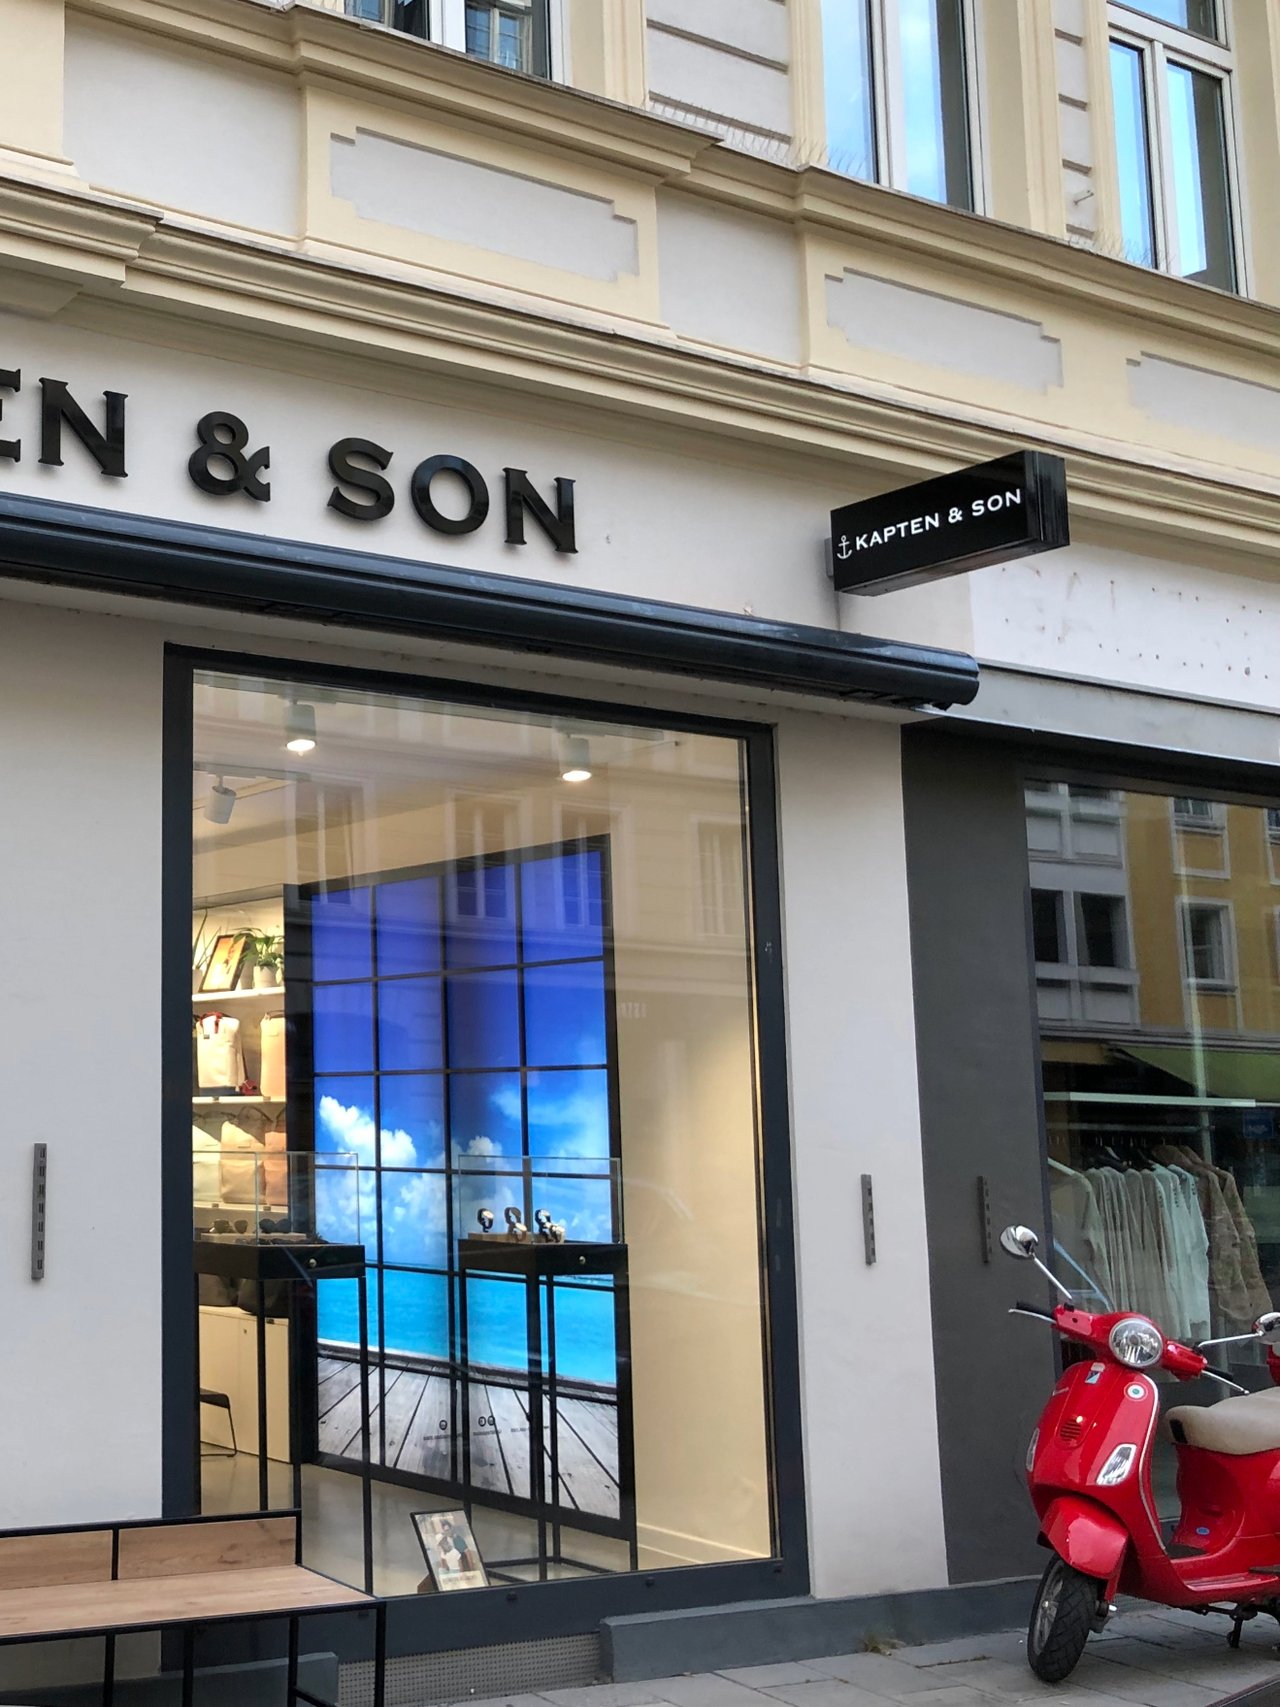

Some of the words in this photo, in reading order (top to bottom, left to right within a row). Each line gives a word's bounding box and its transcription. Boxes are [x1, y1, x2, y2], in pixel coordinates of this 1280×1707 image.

[188, 411, 271, 502] &
[327, 437, 578, 554] SON
[855, 512, 939, 551] KAPTEN
[948, 507, 963, 524] &
[972, 488, 1021, 517] SON
